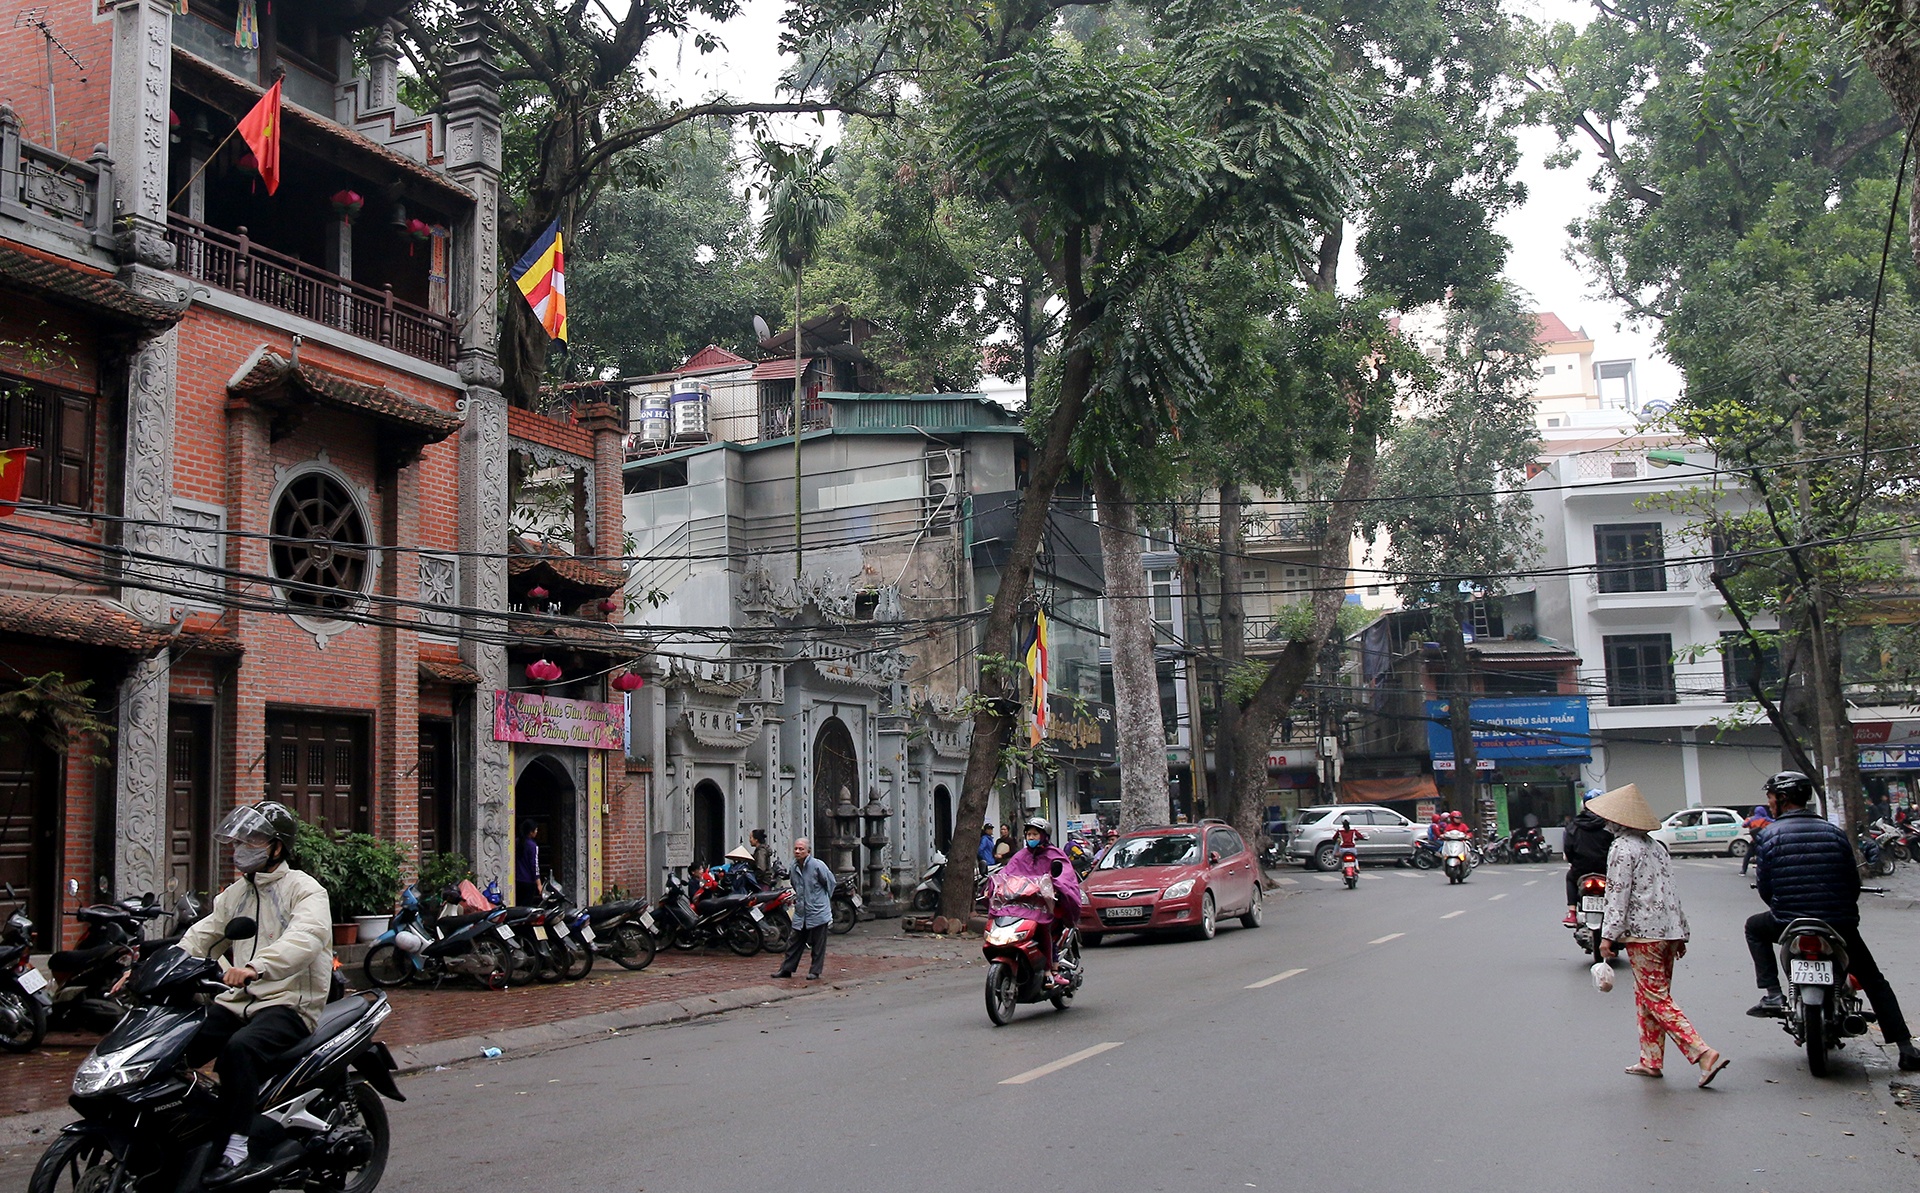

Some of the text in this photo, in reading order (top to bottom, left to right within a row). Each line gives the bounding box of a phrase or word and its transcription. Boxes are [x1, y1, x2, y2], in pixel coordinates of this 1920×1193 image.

[516, 697, 540, 717] Cung
[541, 700, 563, 719] Chúc
[1505, 716, 1528, 727] THIỆU
[1531, 715, 1549, 725] SẢN
[1550, 712, 1575, 723] PHẨM
[523, 720, 539, 737] Cát
[1795, 972, 1830, 983] 773.36
[154, 1100, 183, 1113] HONDA
